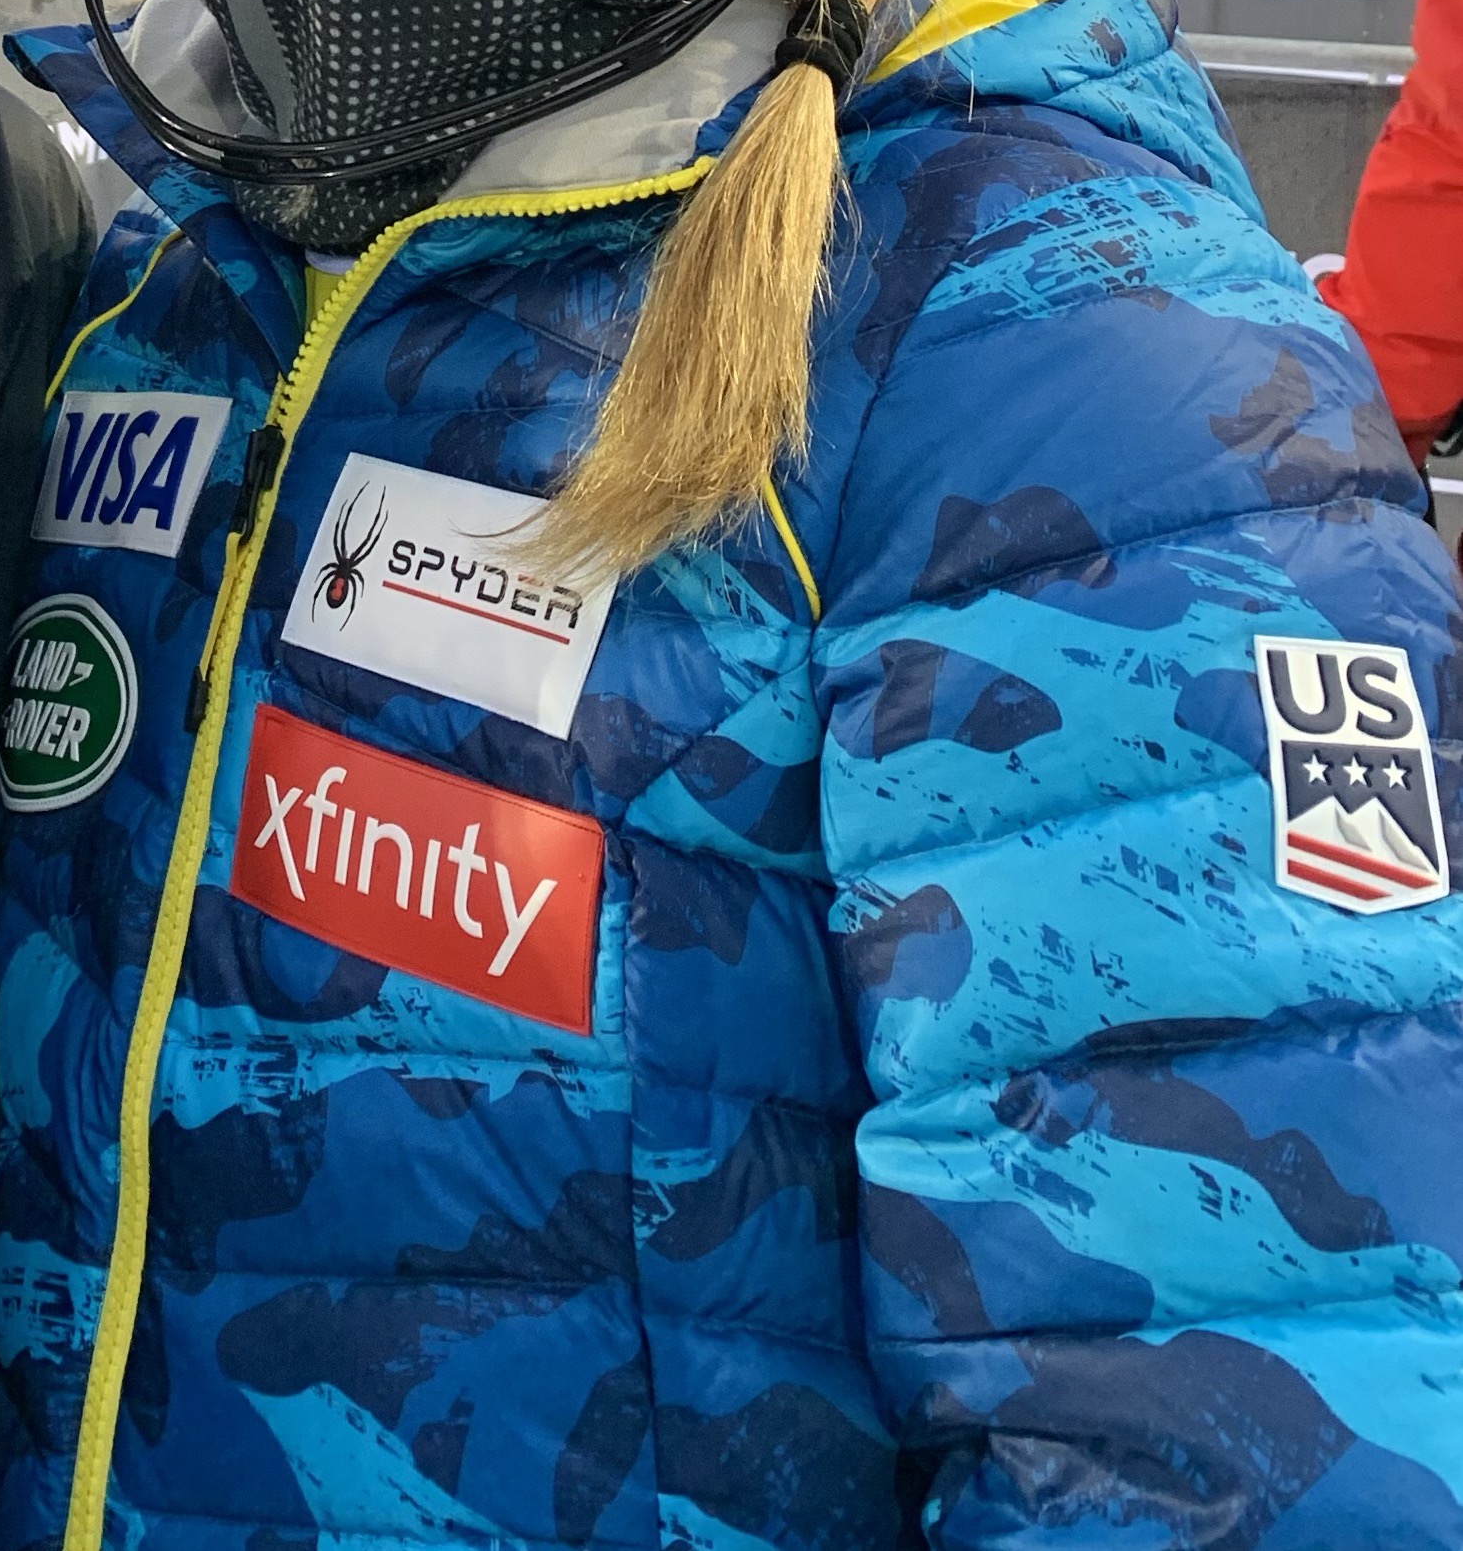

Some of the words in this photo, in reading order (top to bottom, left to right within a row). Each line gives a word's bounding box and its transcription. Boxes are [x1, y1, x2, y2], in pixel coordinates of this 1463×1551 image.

[54, 410, 200, 531] VISA
[387, 539, 584, 630] SPYDER
[3, 697, 91, 763] ROVER
[1266, 649, 1414, 740] US
[253, 765, 559, 978] xfinity
